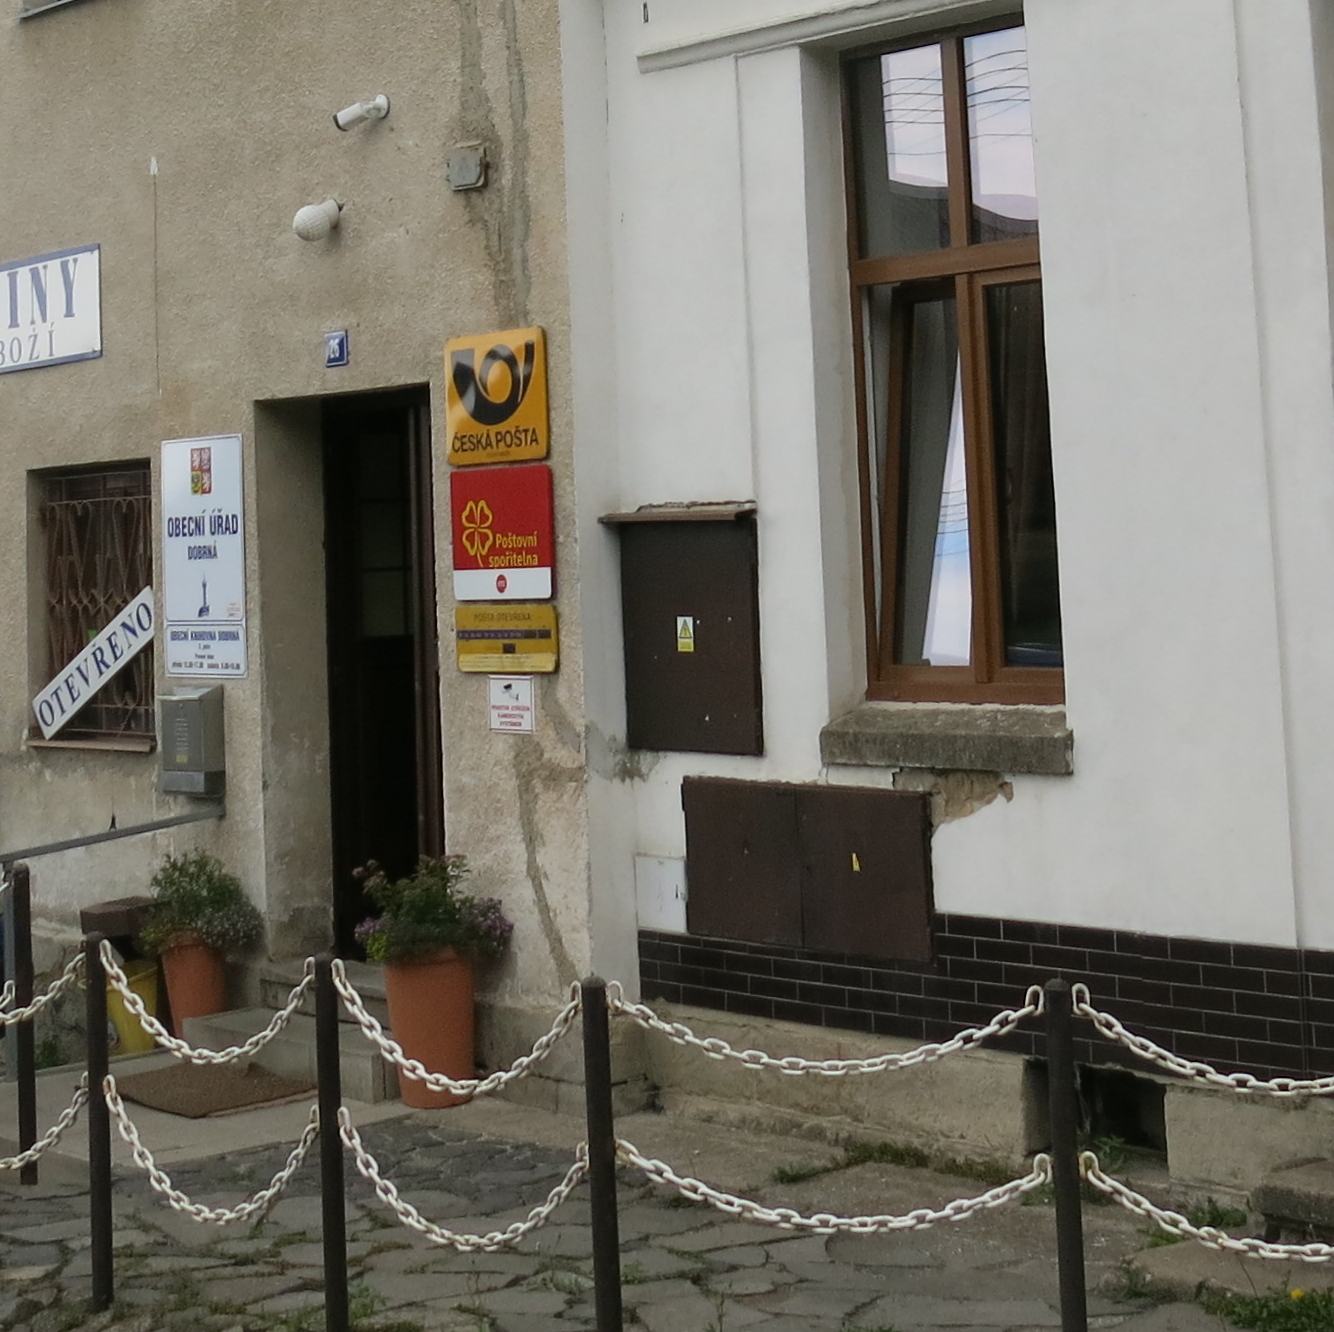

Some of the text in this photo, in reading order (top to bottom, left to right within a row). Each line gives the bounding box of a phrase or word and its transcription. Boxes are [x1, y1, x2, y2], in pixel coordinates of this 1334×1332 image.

[329, 339, 340, 358] 26
[452, 425, 539, 453] ČESKÁ POŠTA
[167, 508, 239, 538] OBECNÍ ÚŘAD
[495, 530, 538, 549] Poštovní
[187, 540, 218, 560] DOBRNÁ
[488, 551, 539, 569] spořitelna
[38, 601, 153, 728] OTEVŘENO
